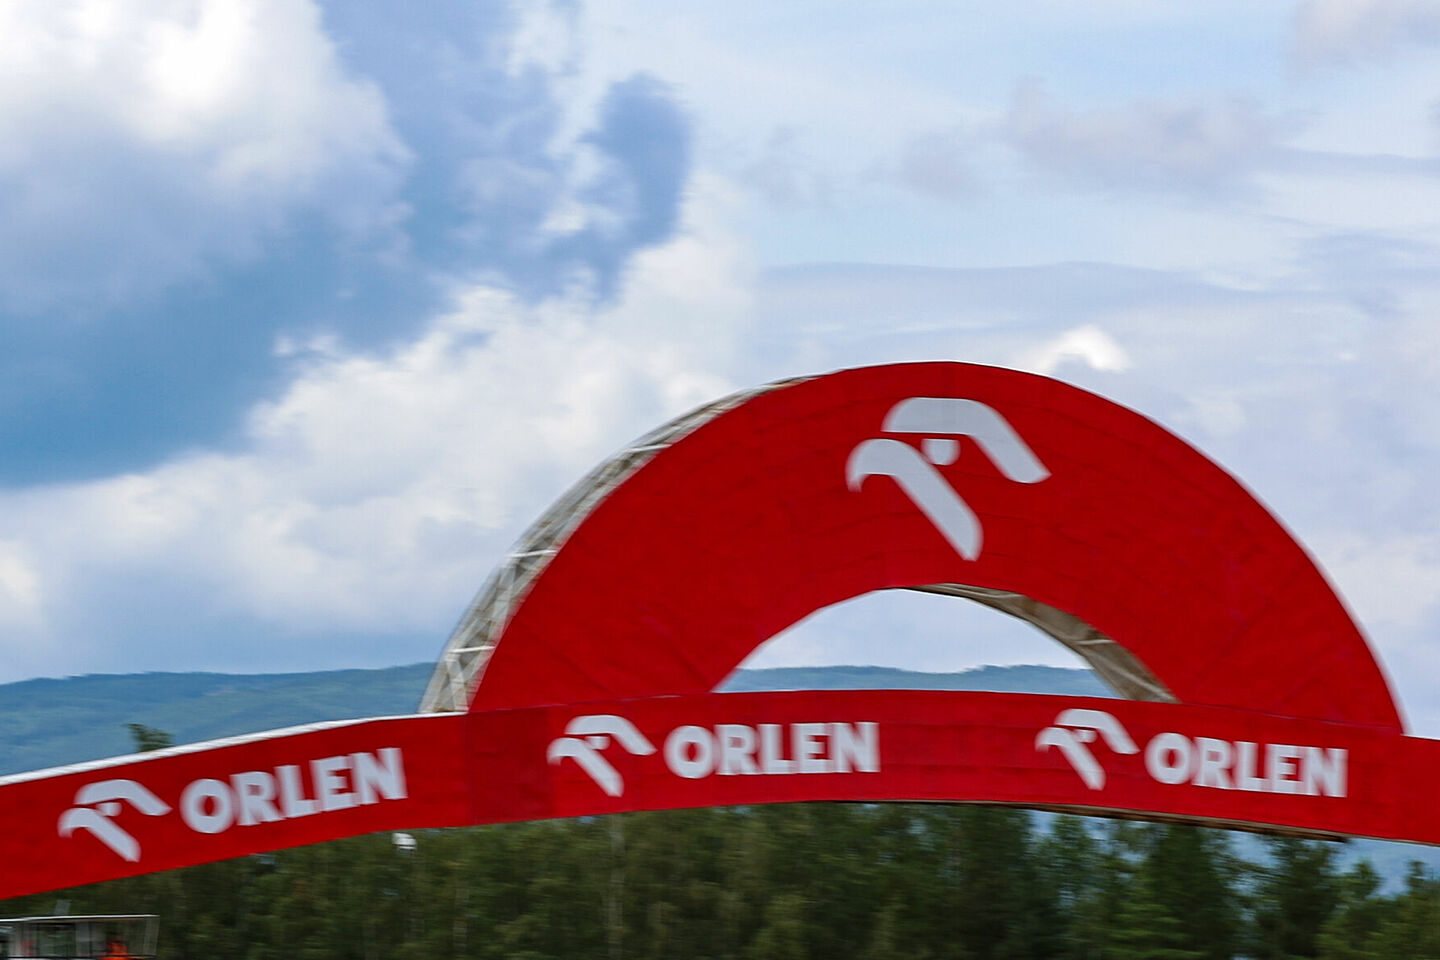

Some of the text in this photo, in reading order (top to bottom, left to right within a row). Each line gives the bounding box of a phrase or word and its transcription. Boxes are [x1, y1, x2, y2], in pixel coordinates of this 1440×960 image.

[663, 721, 881, 779] ORLEN
[1144, 732, 1349, 798] ORLEN
[180, 747, 408, 834] ORLEN
